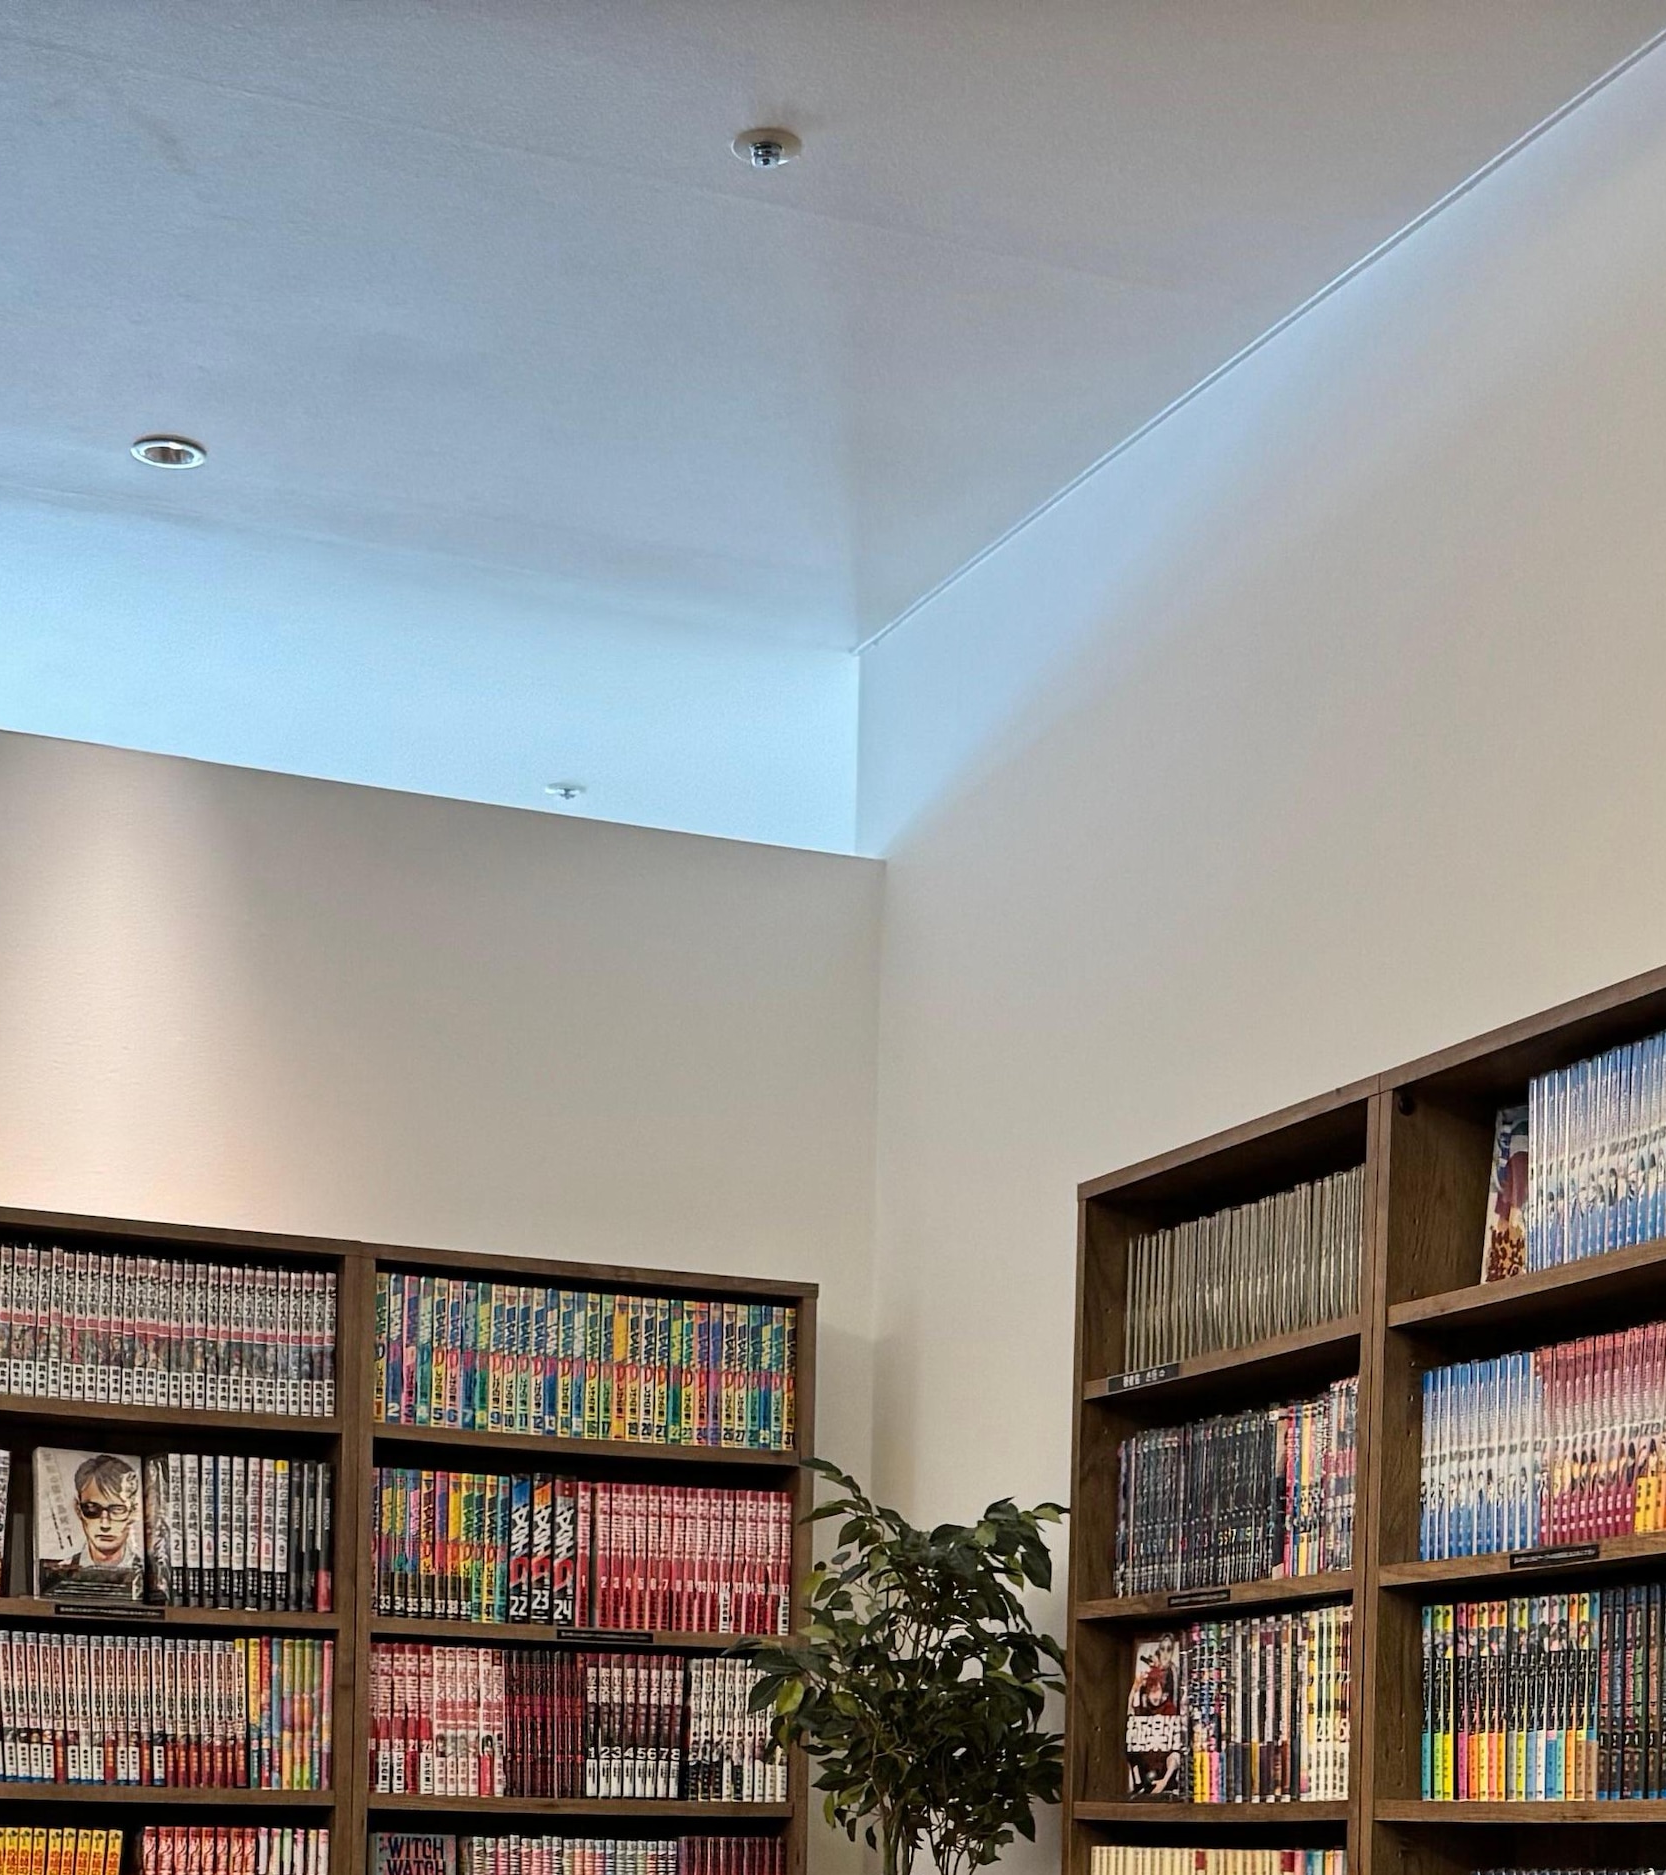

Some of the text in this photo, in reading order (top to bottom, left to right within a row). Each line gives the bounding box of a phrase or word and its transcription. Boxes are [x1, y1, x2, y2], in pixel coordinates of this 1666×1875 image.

[433, 1408, 443, 1421] 5
[490, 1412, 501, 1425] 9
[510, 1597, 527, 1616] 22
[532, 1590, 550, 1610] 23
[554, 1600, 572, 1620] 24
[387, 1837, 444, 1859] WITCH
